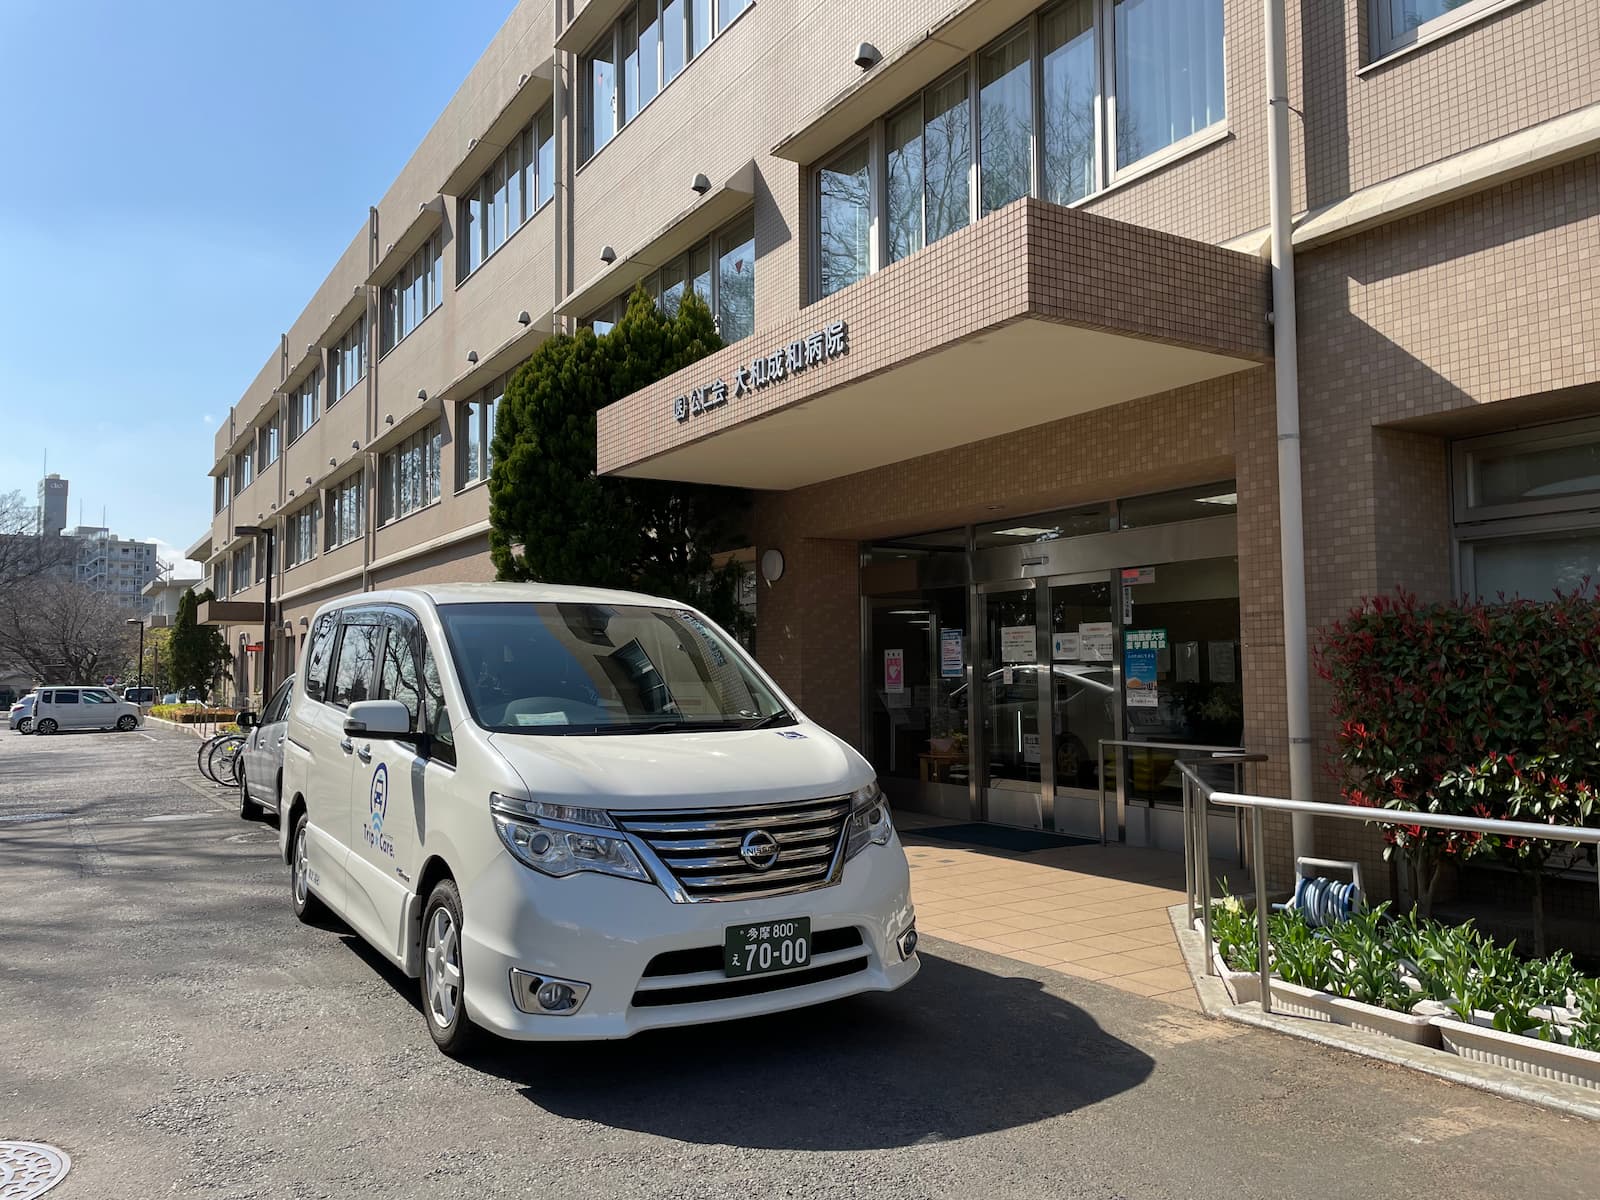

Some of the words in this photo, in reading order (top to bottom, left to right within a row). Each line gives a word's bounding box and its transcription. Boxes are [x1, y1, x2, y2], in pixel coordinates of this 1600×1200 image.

[690, 378, 728, 412] 公仁会
[733, 319, 848, 398] 大和成和病院
[746, 926, 771, 942] 多摩
[772, 922, 794, 938] 800
[731, 953, 741, 966] え
[744, 937, 807, 972] 70-00
